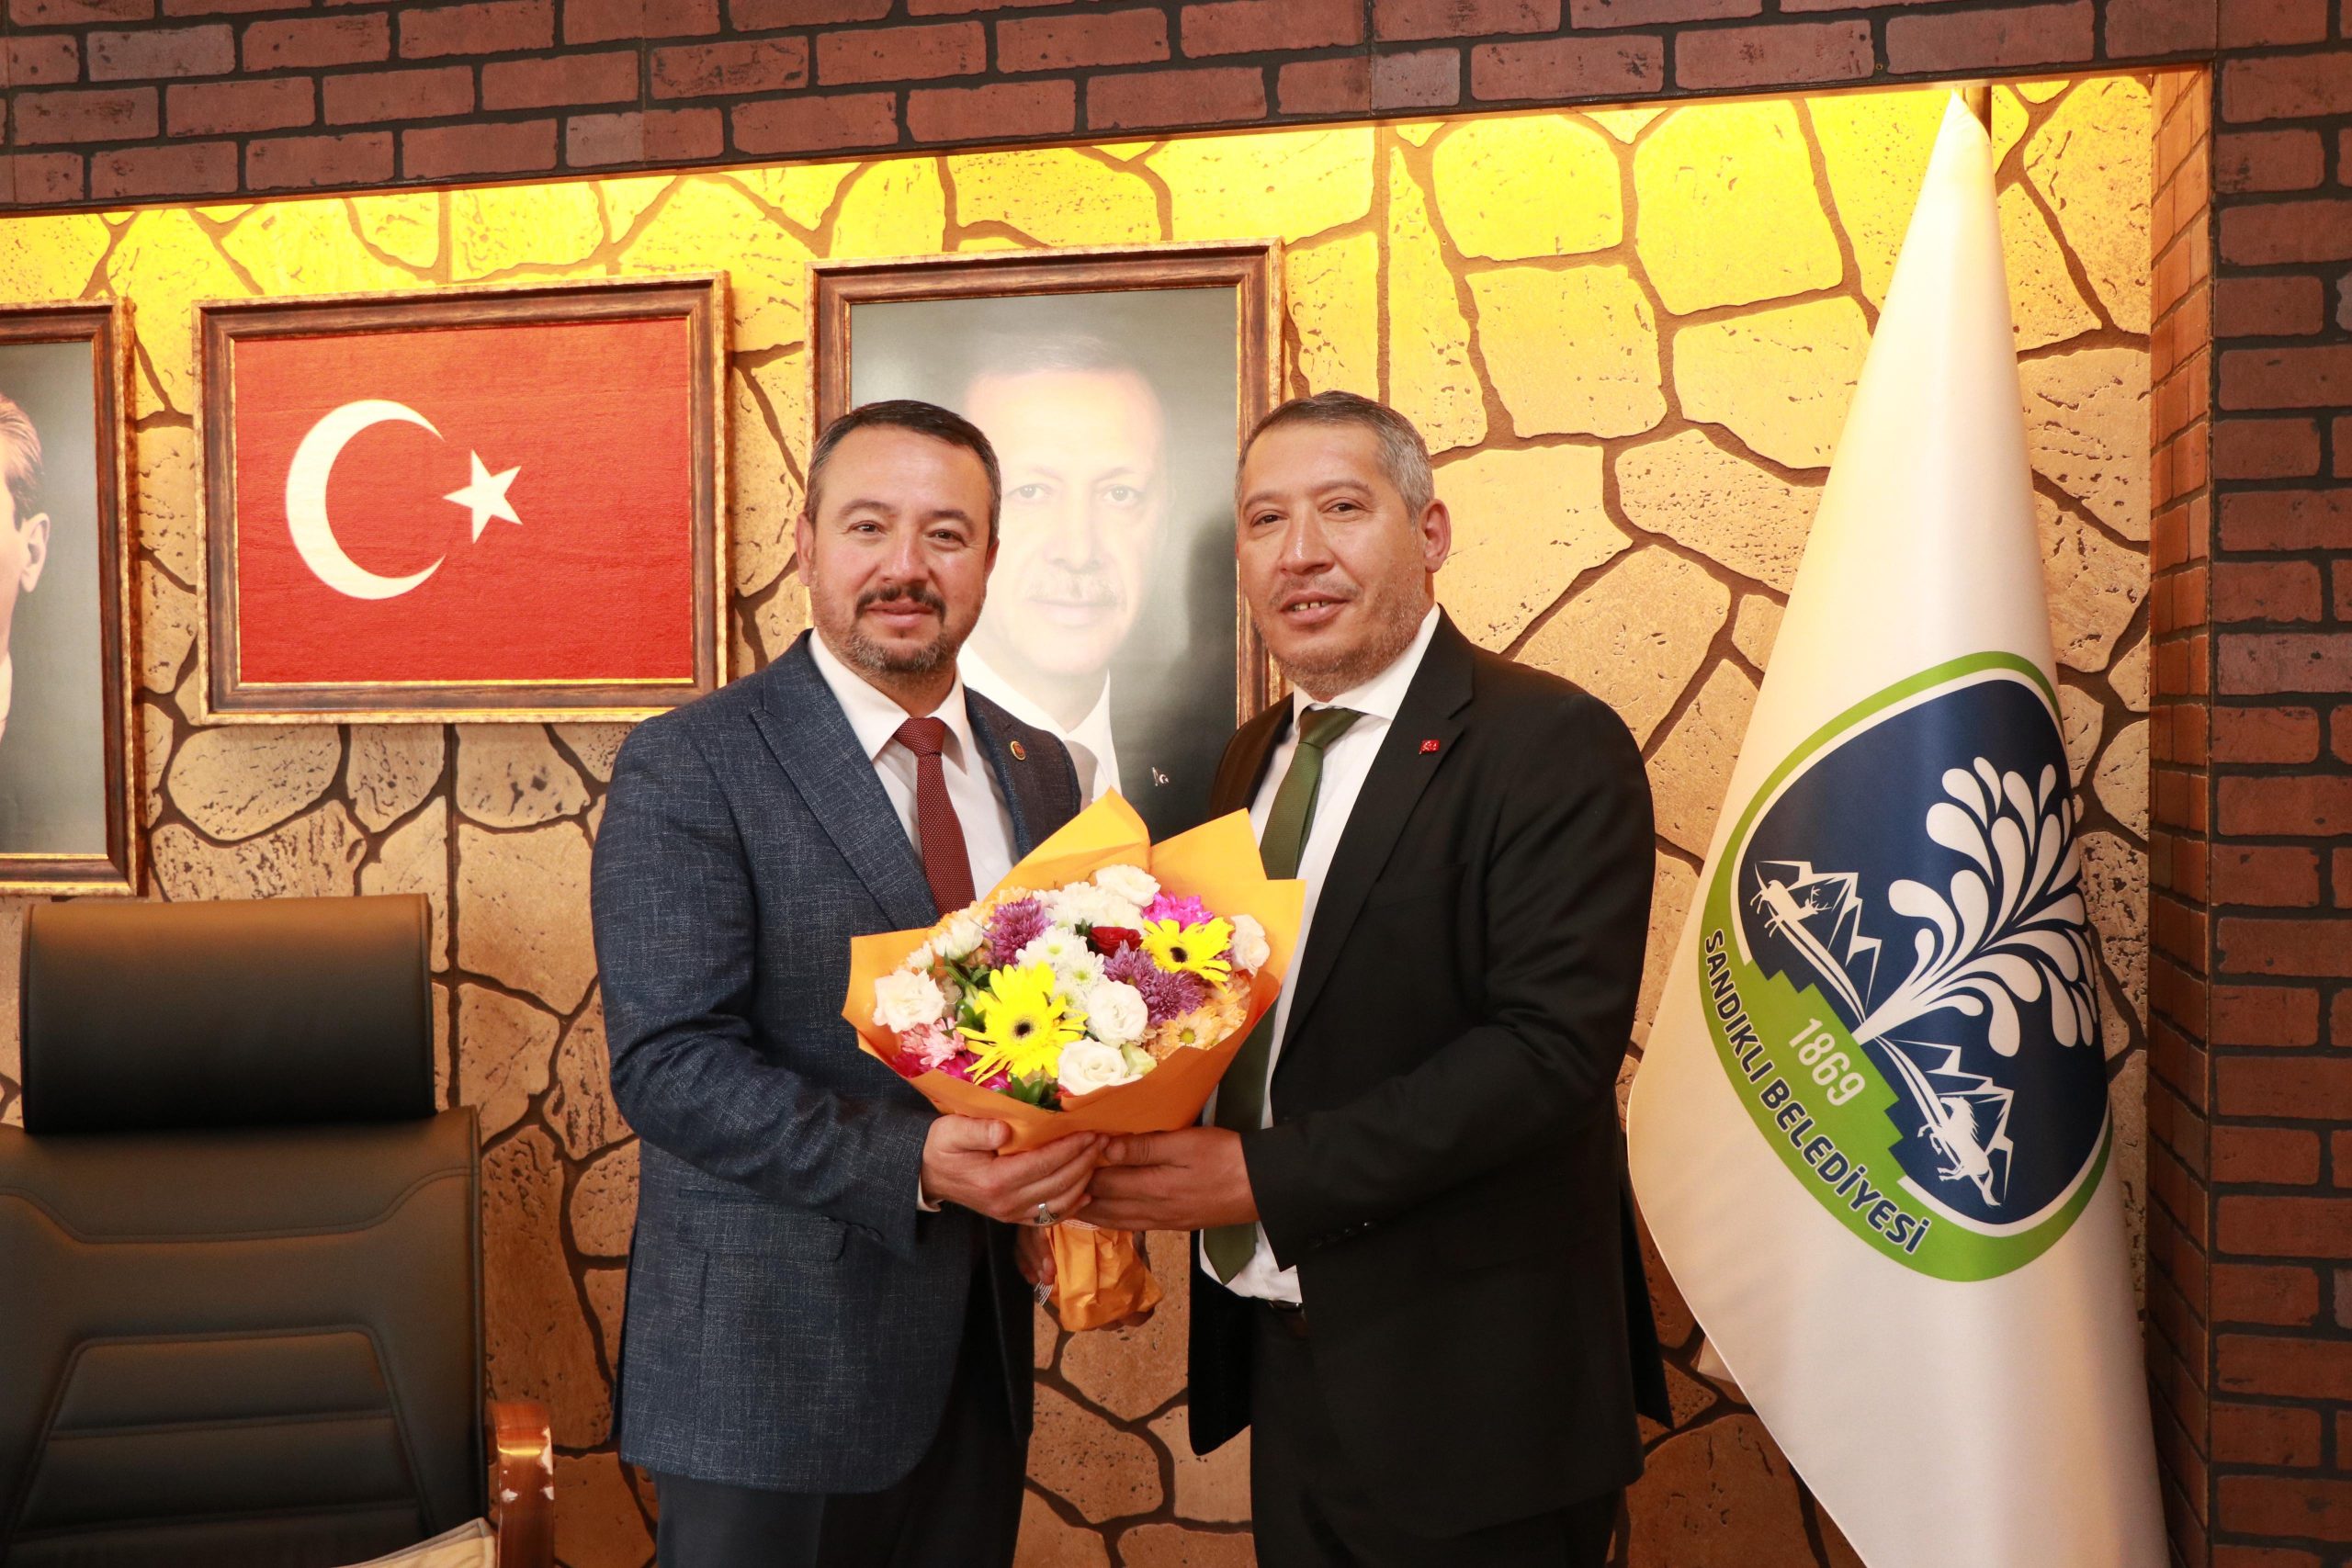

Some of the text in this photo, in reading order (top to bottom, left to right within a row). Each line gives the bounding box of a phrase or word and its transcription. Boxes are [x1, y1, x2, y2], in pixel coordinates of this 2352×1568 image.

[1705, 930, 1931, 1255] SANDIKLI BELEDİYESİ
[1789, 1018, 1865, 1106] 1869
